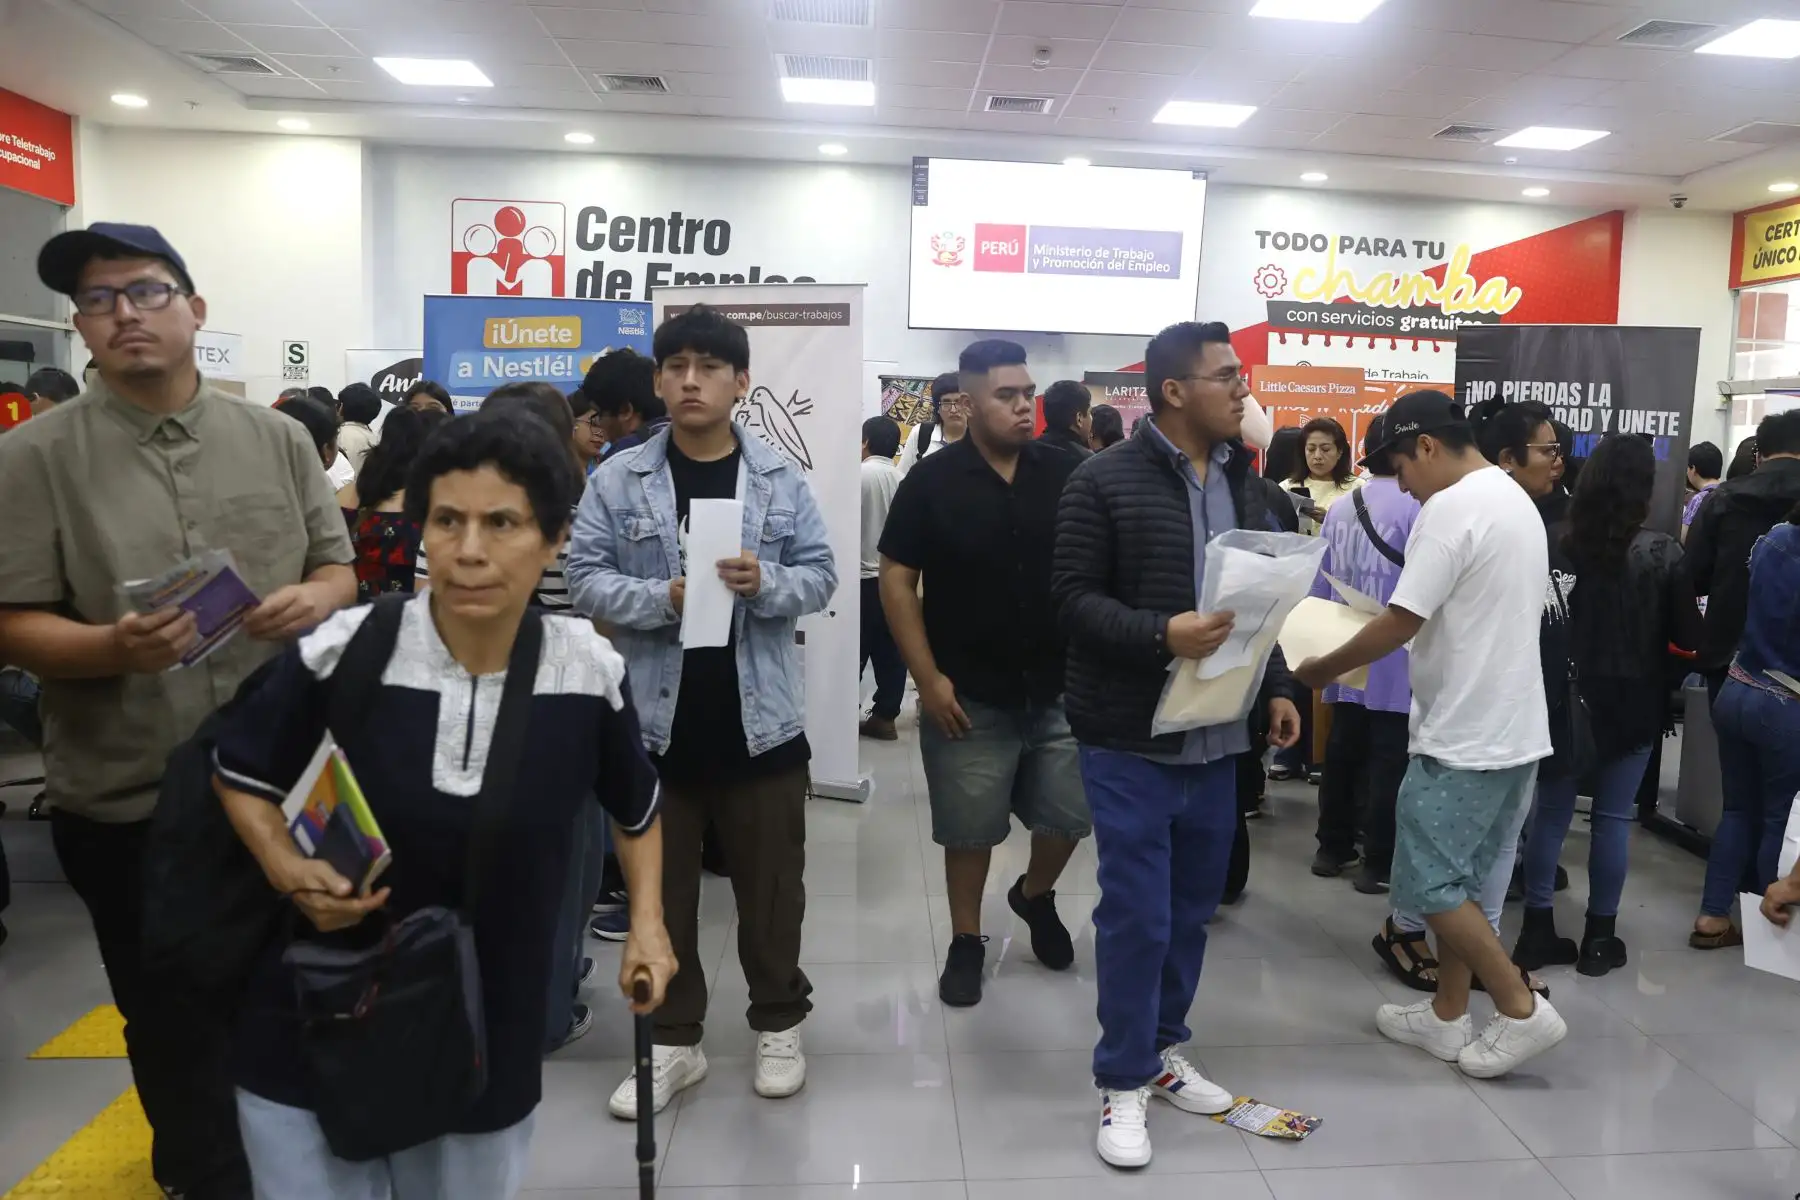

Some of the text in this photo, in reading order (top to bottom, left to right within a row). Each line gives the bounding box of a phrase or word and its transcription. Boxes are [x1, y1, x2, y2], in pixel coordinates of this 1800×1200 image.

[11, 134, 56, 161] Teletrabajo
[576, 205, 731, 256] Centro
[981, 238, 1019, 256] PERÚ
[1033, 244, 1154, 262] Ministerio de Trabajo
[1254, 230, 1445, 260] TODO PARA TU
[1032, 256, 1171, 274] y Promoción del Empleo
[1752, 246, 1797, 270] ÚNICO
[575, 261, 632, 300] de
[1292, 236, 1522, 313] chamba
[1286, 310, 1318, 323] con
[1321, 309, 1395, 327] servicios
[492, 319, 573, 345] ¡Únete
[288, 343, 305, 365] S
[457, 355, 573, 378] a Nestlé!
[1259, 380, 1356, 395] Little Caesars Pizza
[1502, 380, 1582, 407] PIERDAS
[1587, 382, 1612, 407] LA
[7, 401, 19, 421] 1
[1600, 408, 1613, 433] Y
[1617, 409, 1680, 437] UNETE
[1394, 420, 1420, 435] Smile
